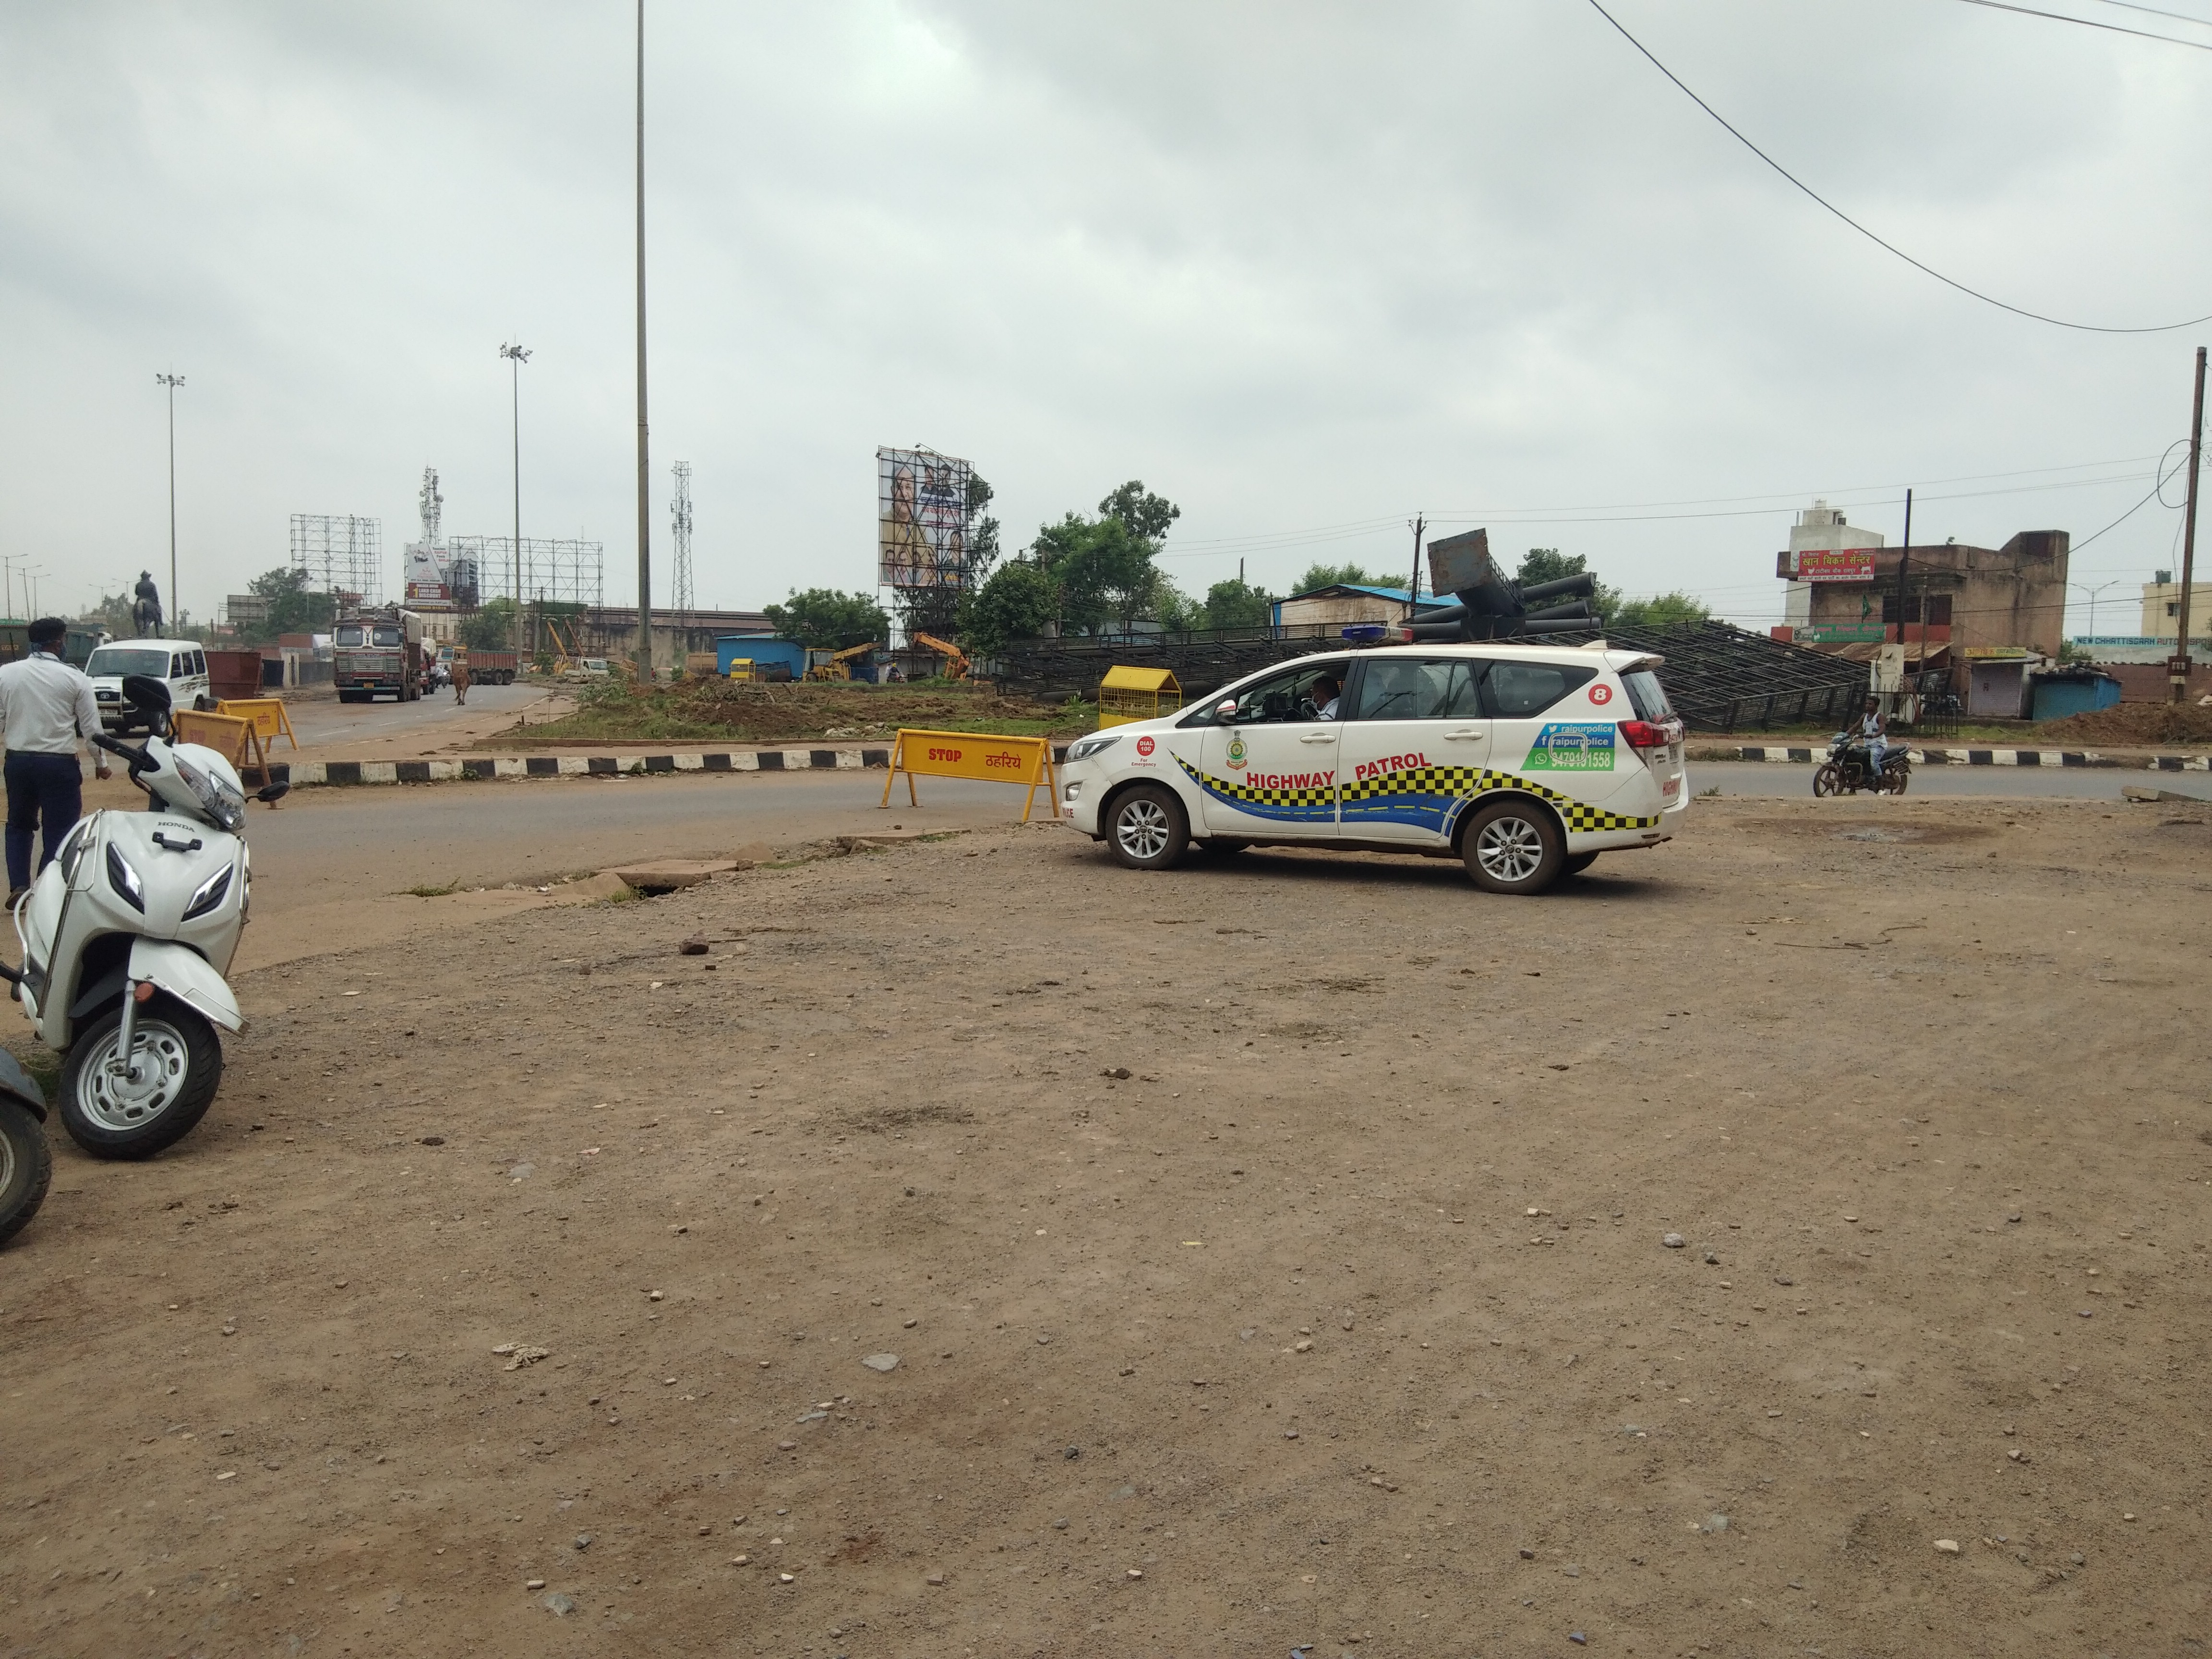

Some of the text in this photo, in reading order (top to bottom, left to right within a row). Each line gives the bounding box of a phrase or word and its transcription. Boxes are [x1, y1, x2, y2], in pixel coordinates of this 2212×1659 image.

[1803, 553, 1871, 566] खान चिकन सेन्टर
[1594, 688, 1607, 701] 8
[1561, 724, 1613, 733] raipurpolice
[1552, 737, 1608, 746] raipurpolice
[929, 748, 962, 762] STOP
[986, 751, 1021, 769] ठहरिये
[1247, 753, 1431, 789] HIGHWAY PATROL
[157, 822, 195, 832] HONDA
